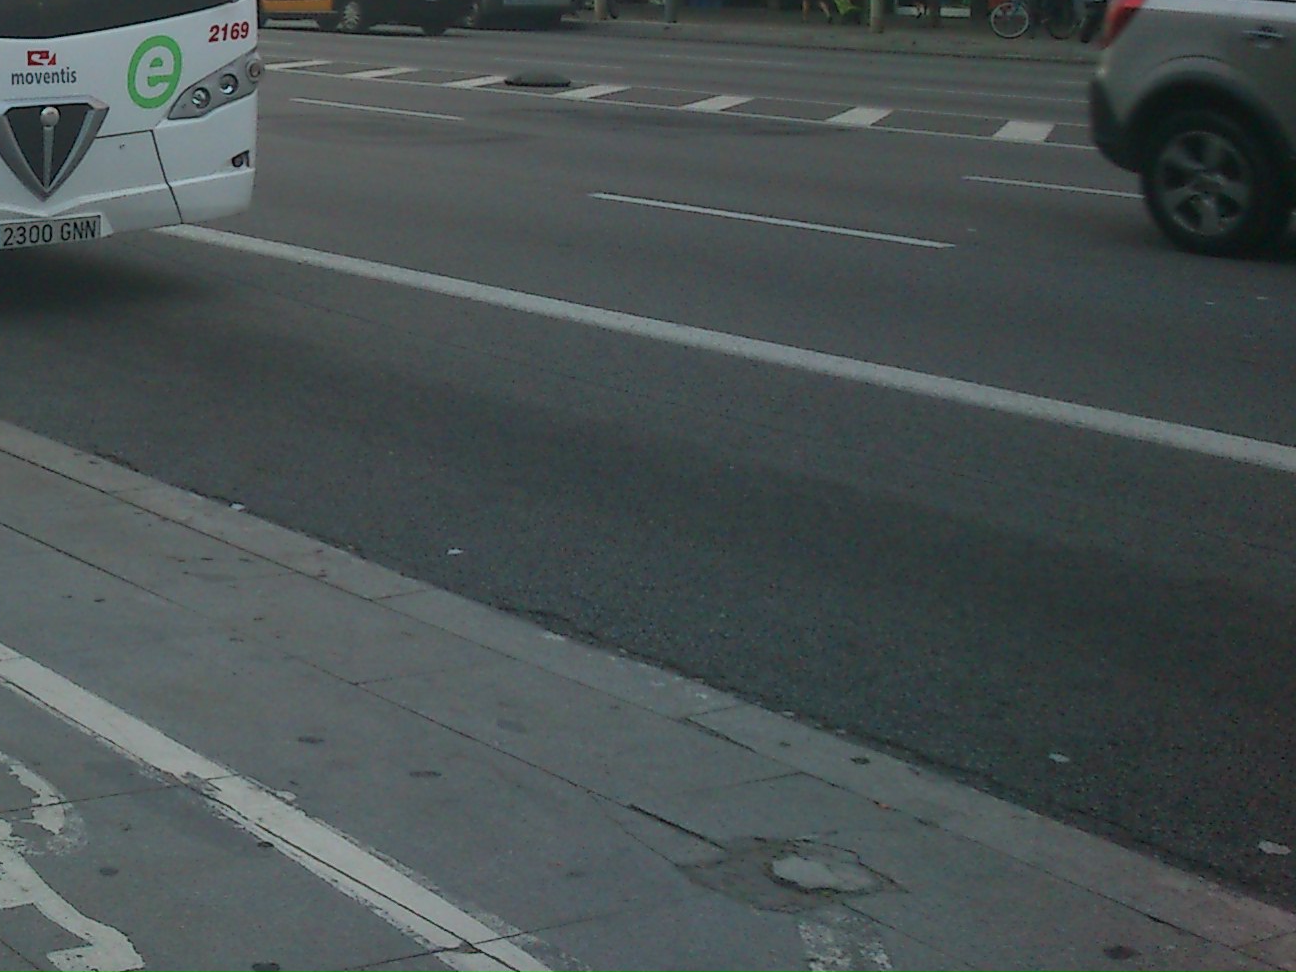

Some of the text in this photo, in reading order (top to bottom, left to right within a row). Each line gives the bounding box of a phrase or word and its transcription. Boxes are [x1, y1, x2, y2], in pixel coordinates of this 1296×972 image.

[208, 21, 250, 43] 2169
[11, 67, 77, 86] moventis
[3, 221, 97, 247] 2300 GNN
